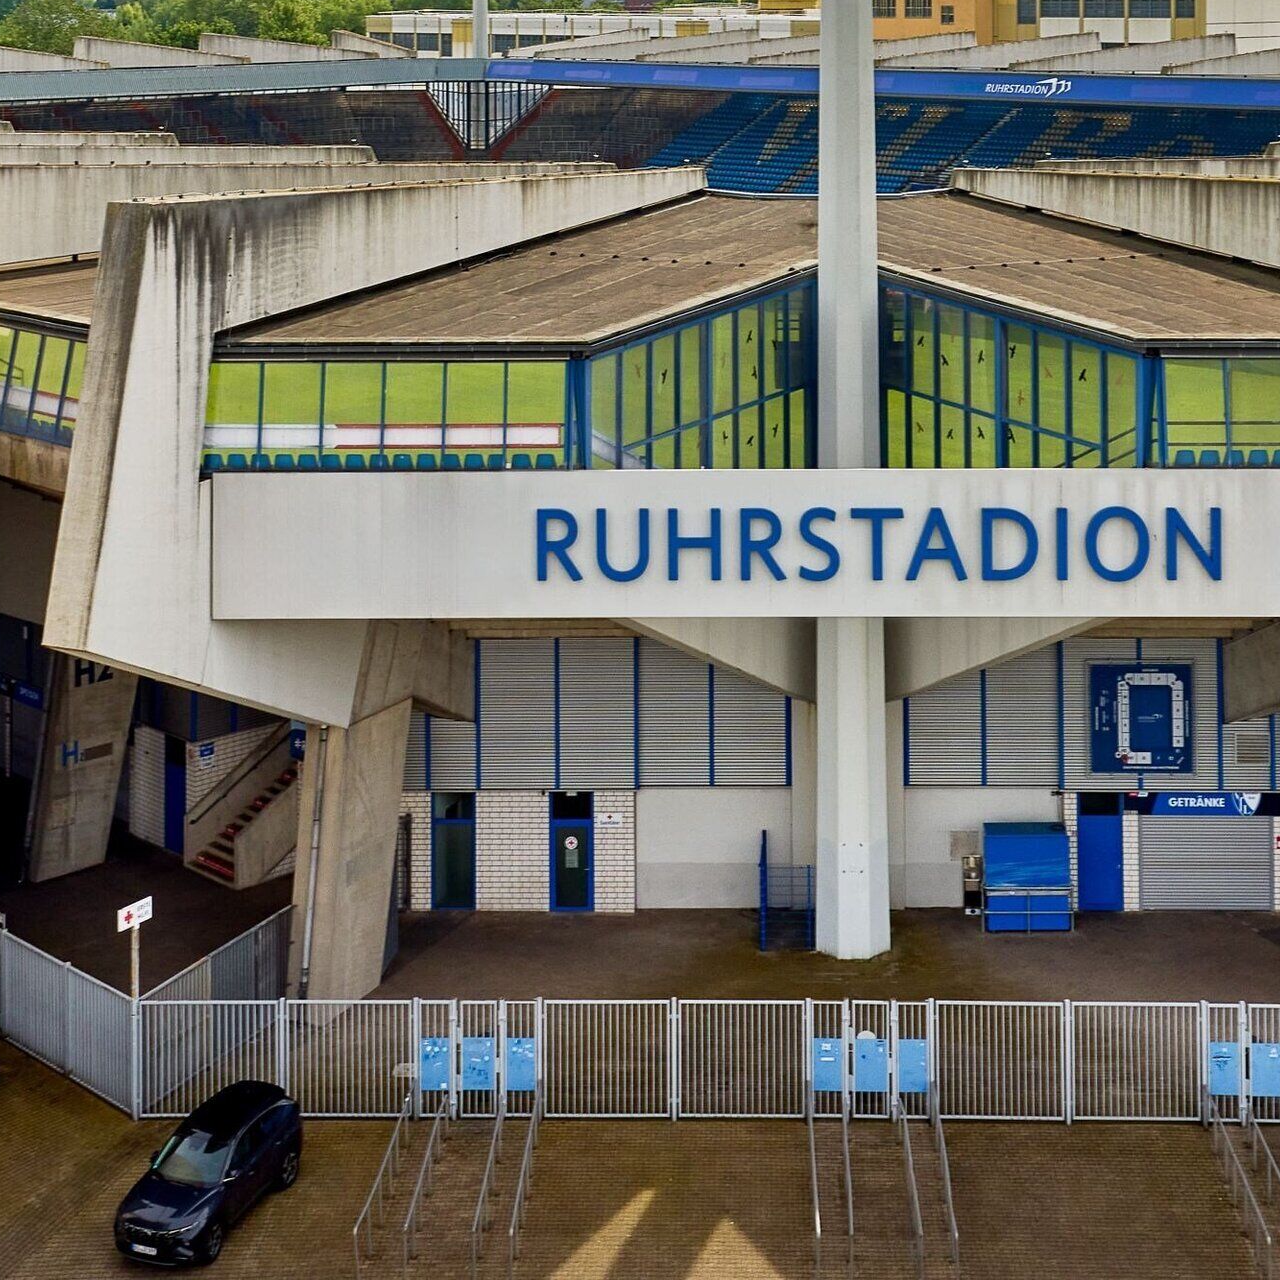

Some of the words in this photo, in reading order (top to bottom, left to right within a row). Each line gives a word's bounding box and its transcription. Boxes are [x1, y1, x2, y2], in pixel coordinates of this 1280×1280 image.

[985, 83, 1049, 95] RUHRSTADION
[535, 506, 1223, 582] RUHRSTADION
[1168, 795, 1226, 808] GETRÄNKE
